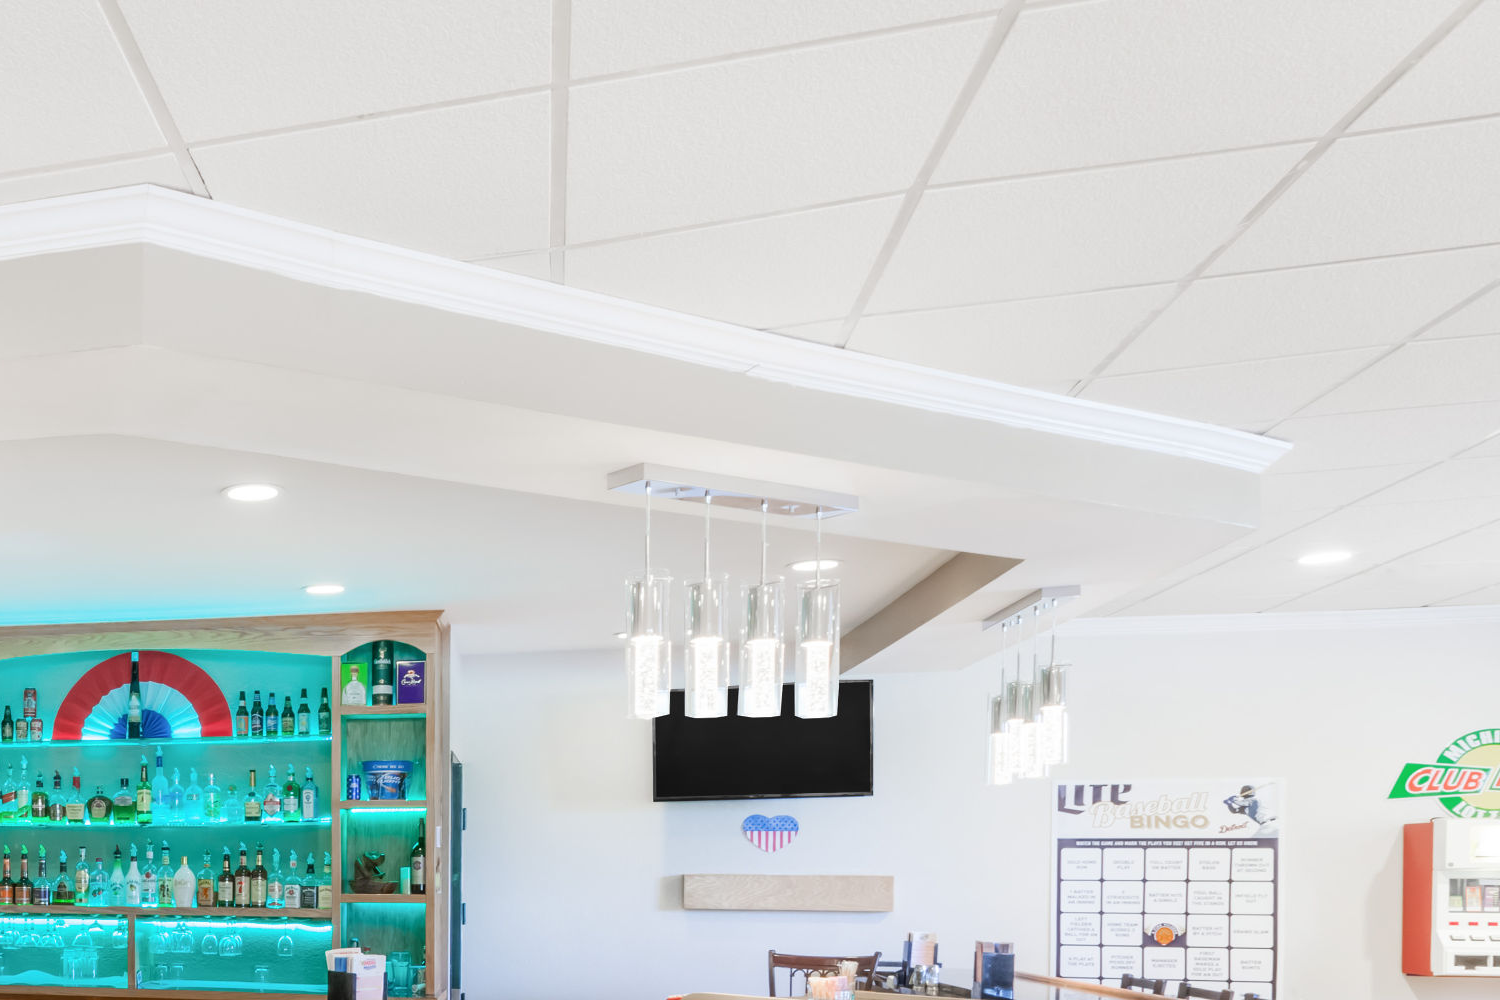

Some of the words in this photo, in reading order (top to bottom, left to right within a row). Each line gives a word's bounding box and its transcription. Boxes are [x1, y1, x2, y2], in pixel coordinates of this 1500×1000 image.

[1406, 767, 1485, 793] CLUB
[1088, 792, 1210, 829] Baseball
[1129, 814, 1210, 829] BINGO
